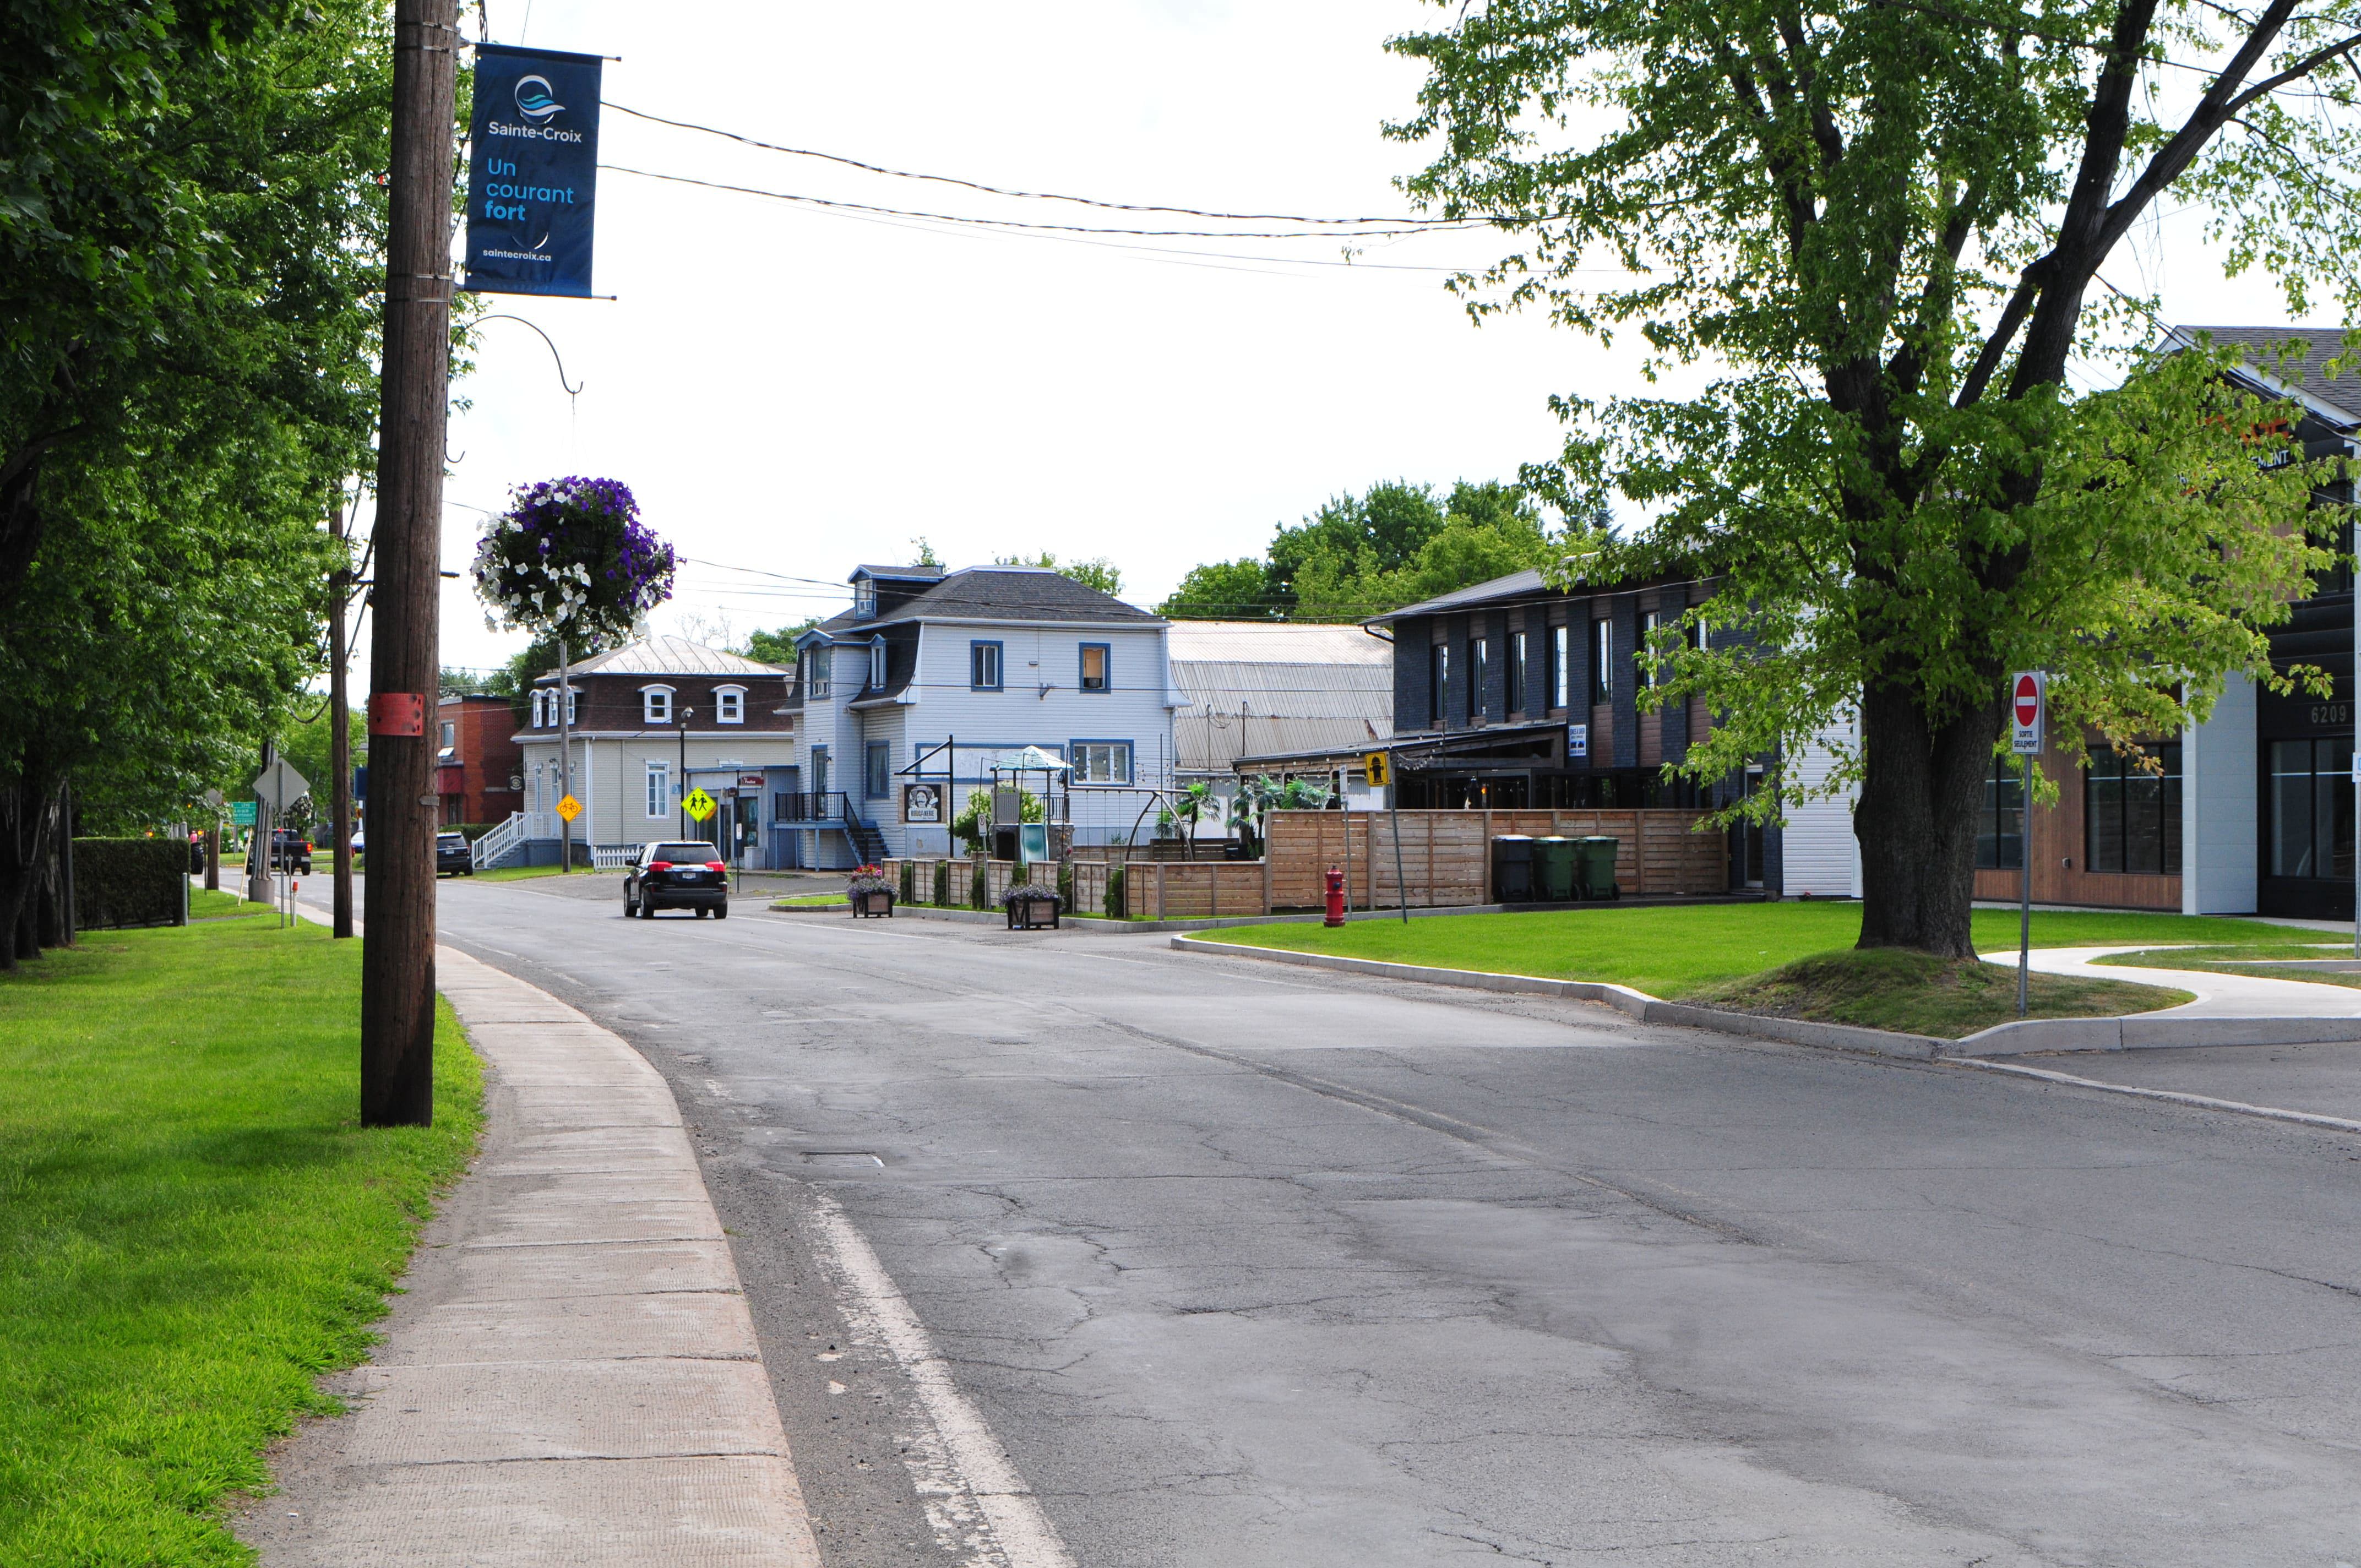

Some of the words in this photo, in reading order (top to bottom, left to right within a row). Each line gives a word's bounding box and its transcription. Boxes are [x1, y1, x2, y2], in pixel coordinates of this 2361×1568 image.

[488, 121, 582, 143] Sainte-Croix
[488, 158, 516, 176] Un
[486, 183, 574, 204] courant
[485, 200, 525, 221] fort
[482, 249, 551, 262] saintecroix.ca
[2311, 705, 2346, 723] 6209
